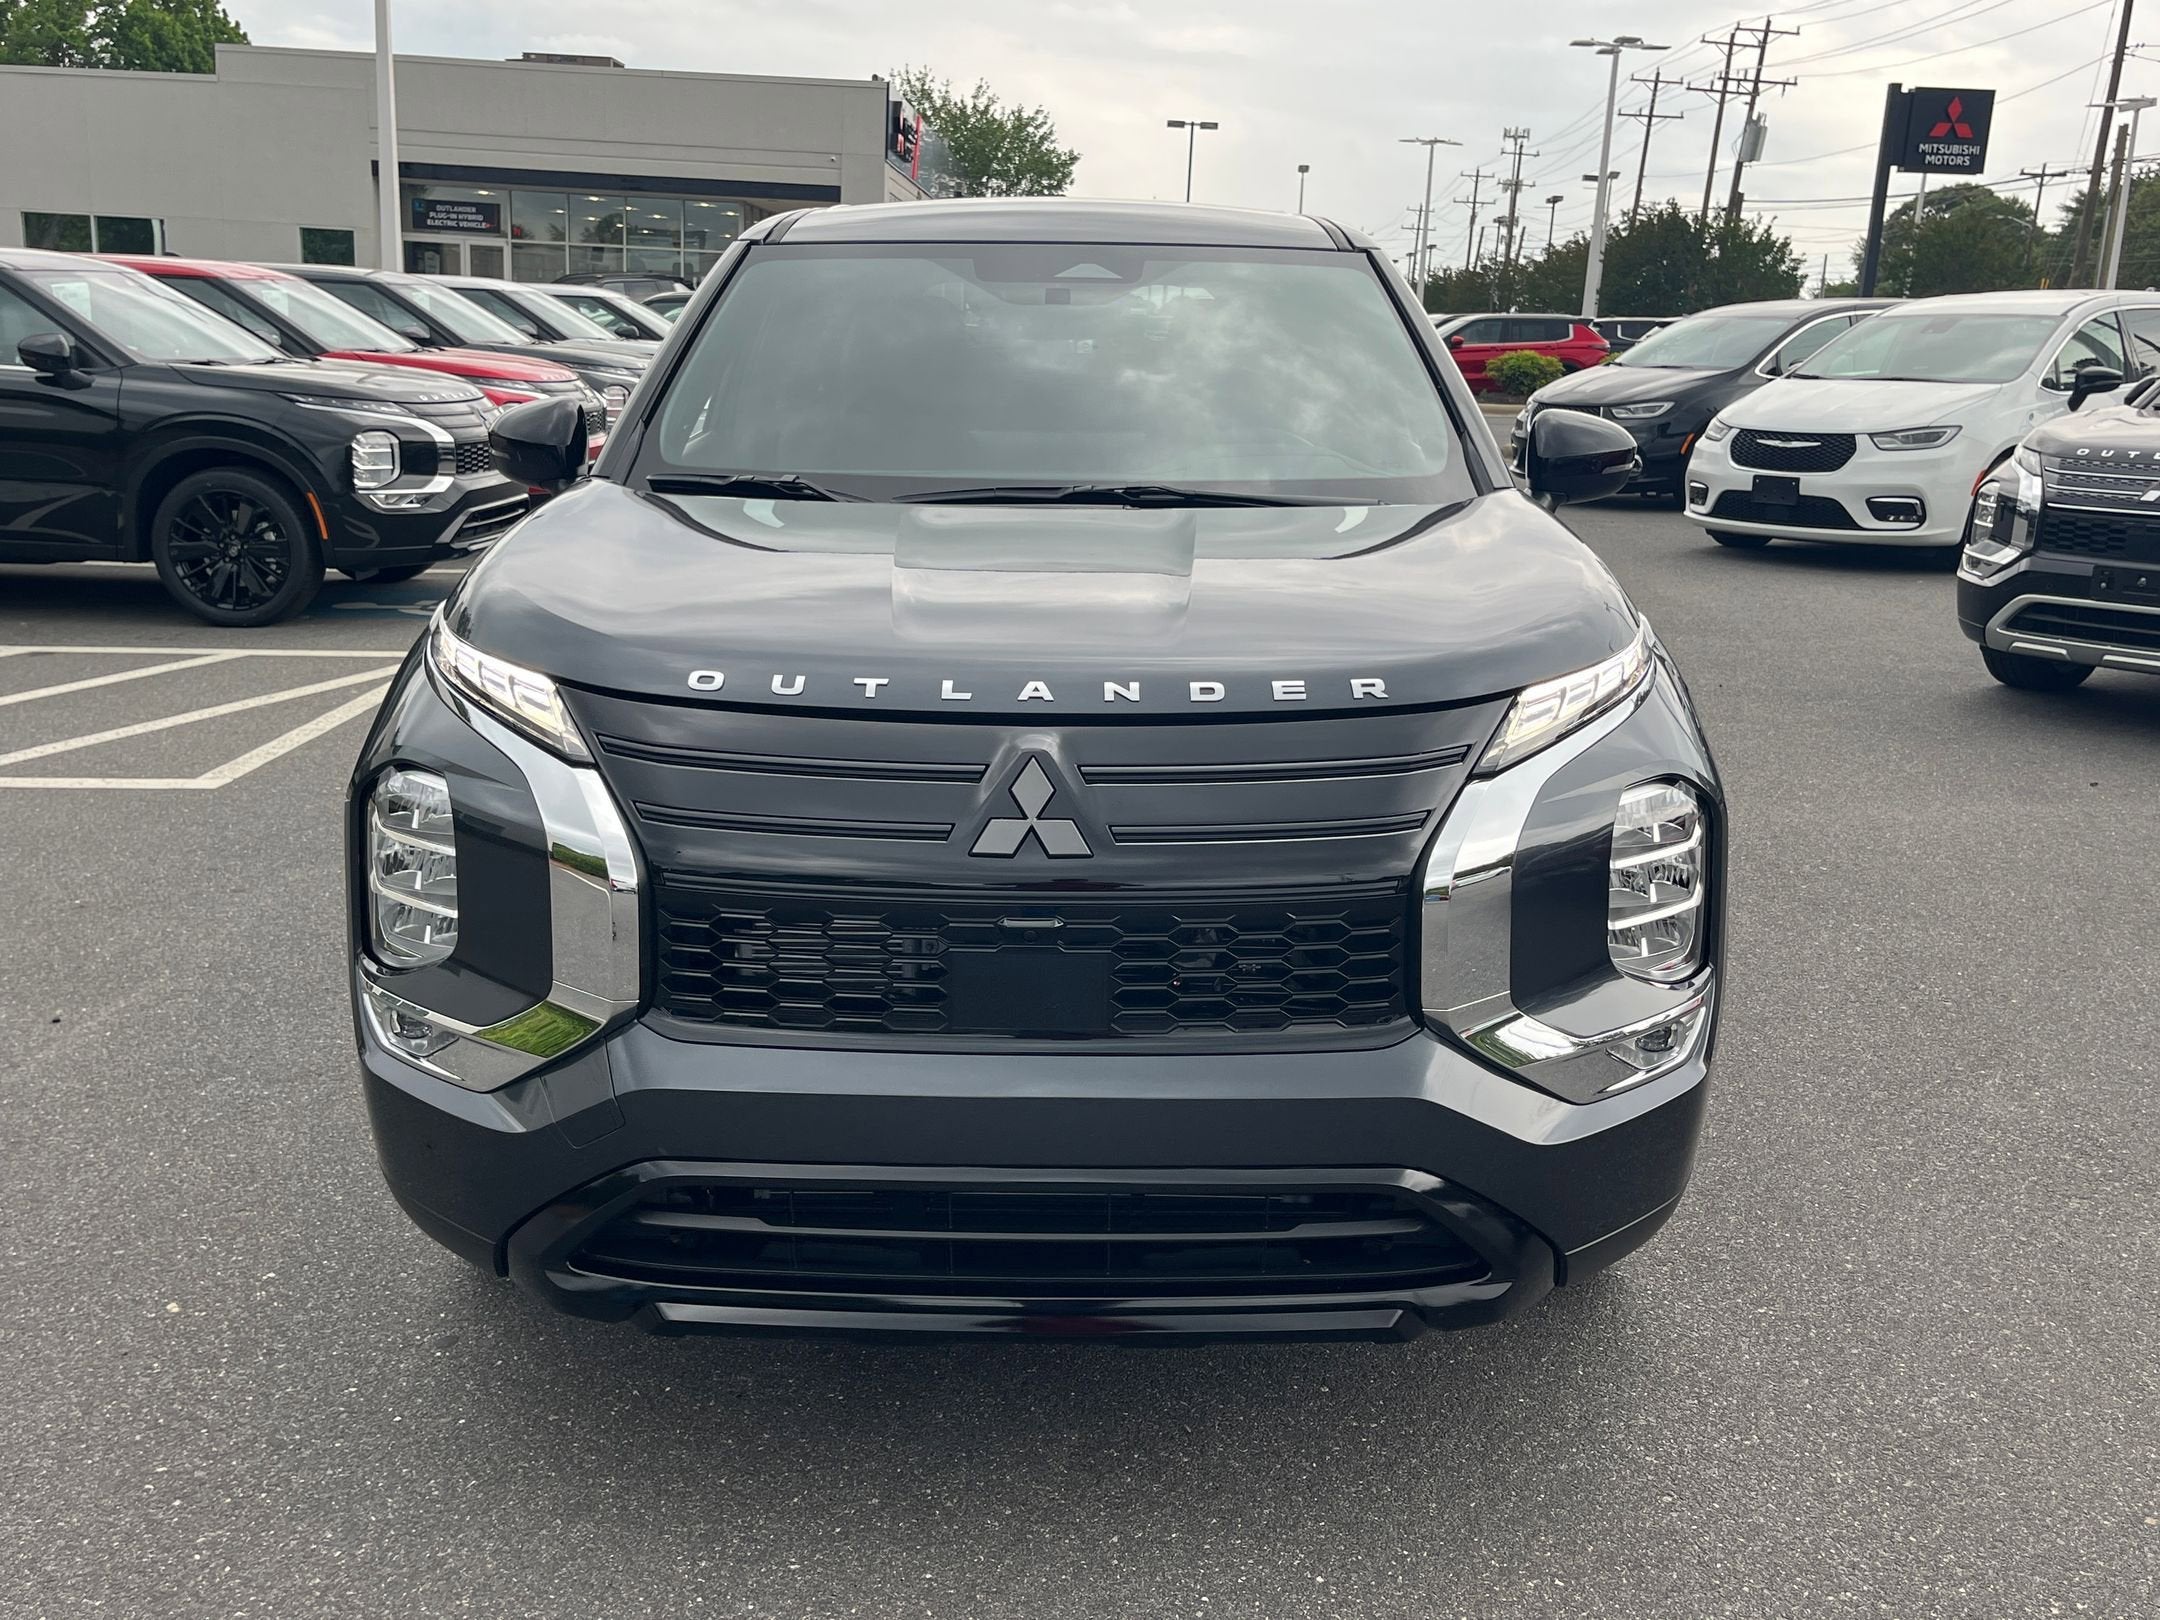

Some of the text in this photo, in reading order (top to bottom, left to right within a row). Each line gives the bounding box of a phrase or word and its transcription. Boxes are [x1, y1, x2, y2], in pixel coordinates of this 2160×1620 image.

[1918, 143, 1980, 155] MITSUBISHI
[1924, 155, 1971, 166] MOTORS
[435, 204, 477, 213] OUTLANDER
[428, 211, 484, 221] PLUG-IN HYBRID
[426, 218, 487, 229] ELECTRIC VEHICLE
[687, 670, 1389, 701] OUTLANDER
